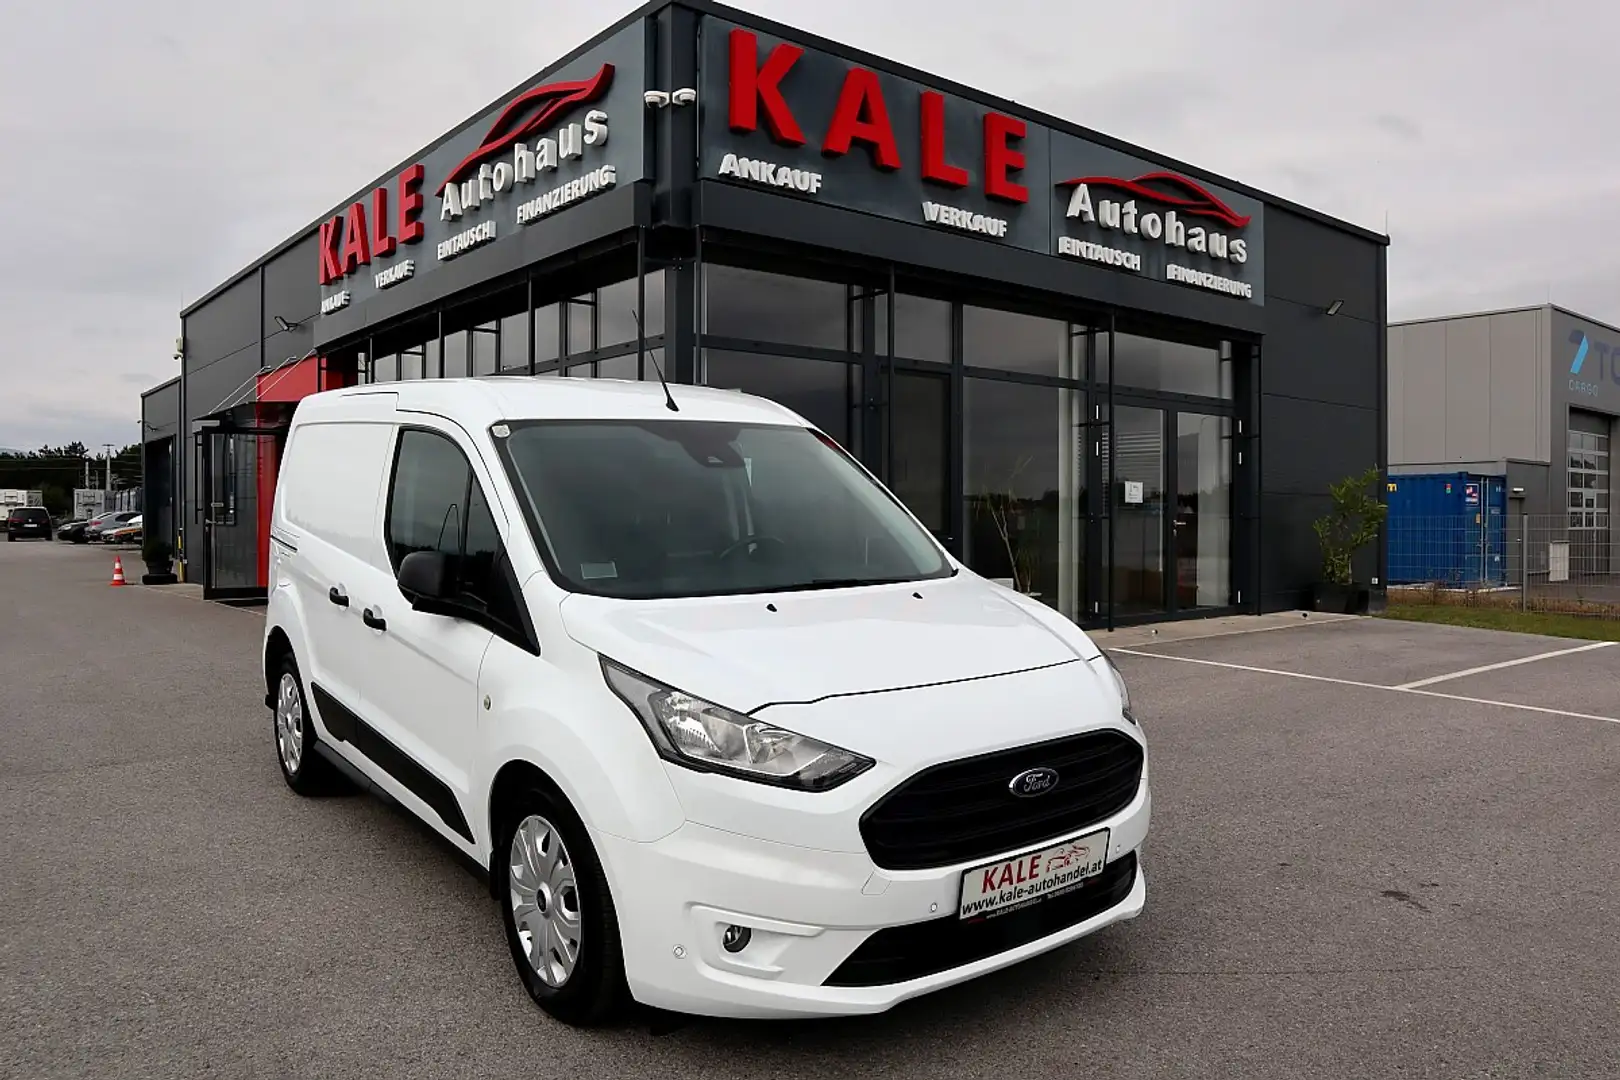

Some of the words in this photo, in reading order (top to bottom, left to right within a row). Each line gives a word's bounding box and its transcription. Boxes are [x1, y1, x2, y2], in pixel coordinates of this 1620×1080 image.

[728, 27, 1029, 204] KALE
[440, 109, 609, 222] Autohaus
[718, 152, 823, 195] ANKAUF
[516, 164, 617, 225] FINANZIERUNG
[318, 163, 424, 286] KALE
[437, 219, 497, 261] EINTAUSCH
[922, 201, 1008, 238] VERKAUF
[1066, 183, 1248, 264] Autohaus
[1058, 235, 1141, 272] EINTAUSCH
[1166, 263, 1253, 299] FINANZIERUNG
[1568, 379, 1599, 398] CARGO
[1023, 772, 1051, 793] Ford
[961, 858, 1103, 916] www.kale-autohandel.at
[981, 854, 1042, 894] KALE
